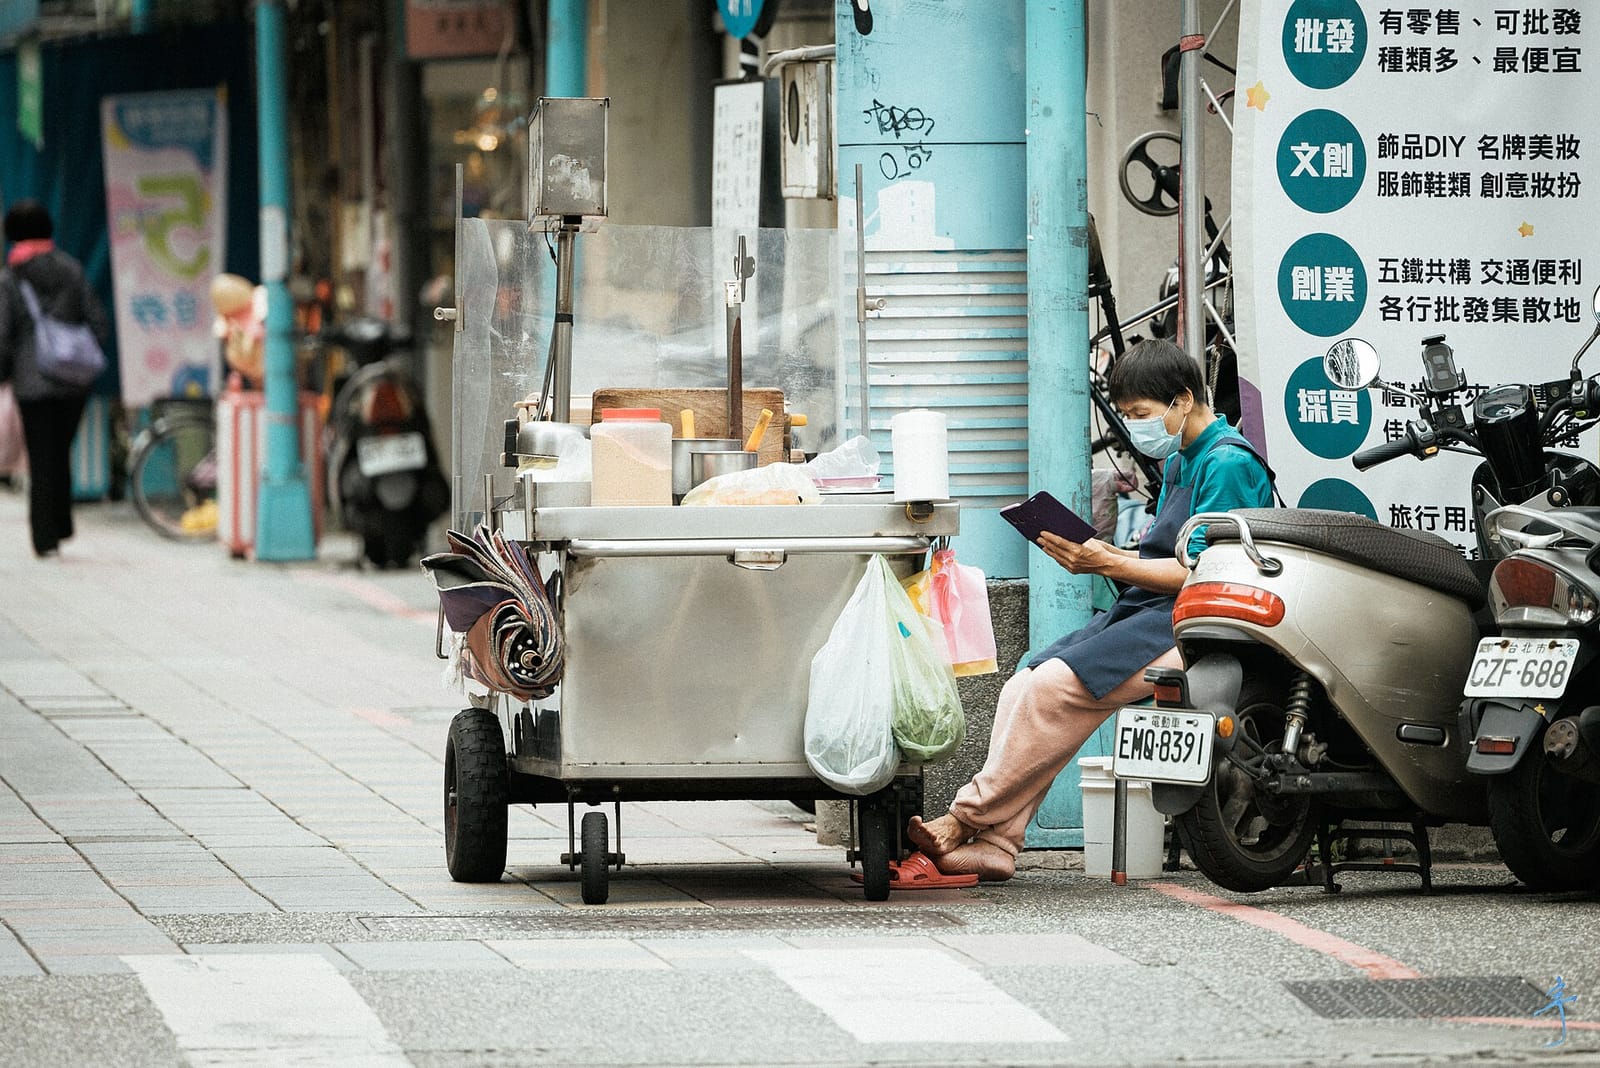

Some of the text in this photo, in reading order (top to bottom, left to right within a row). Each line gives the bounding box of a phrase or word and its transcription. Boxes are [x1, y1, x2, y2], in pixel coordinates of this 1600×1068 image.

[1294, 17, 1356, 54] 批發
[1379, 8, 1582, 36] 有零售、可批發
[1377, 46, 1582, 74] 種類多、最便宜
[1289, 141, 1354, 178] 文創
[1377, 132, 1581, 161] 飾品DIY 名牌美妝
[1377, 170, 1582, 199] 服飾鞋類 創意妝扮
[1290, 265, 1355, 302] 創業
[1377, 257, 1582, 286] 五鐵共構 交通便利
[1379, 295, 1581, 323] 各行批發集散地
[1297, 388, 1360, 425] 採買
